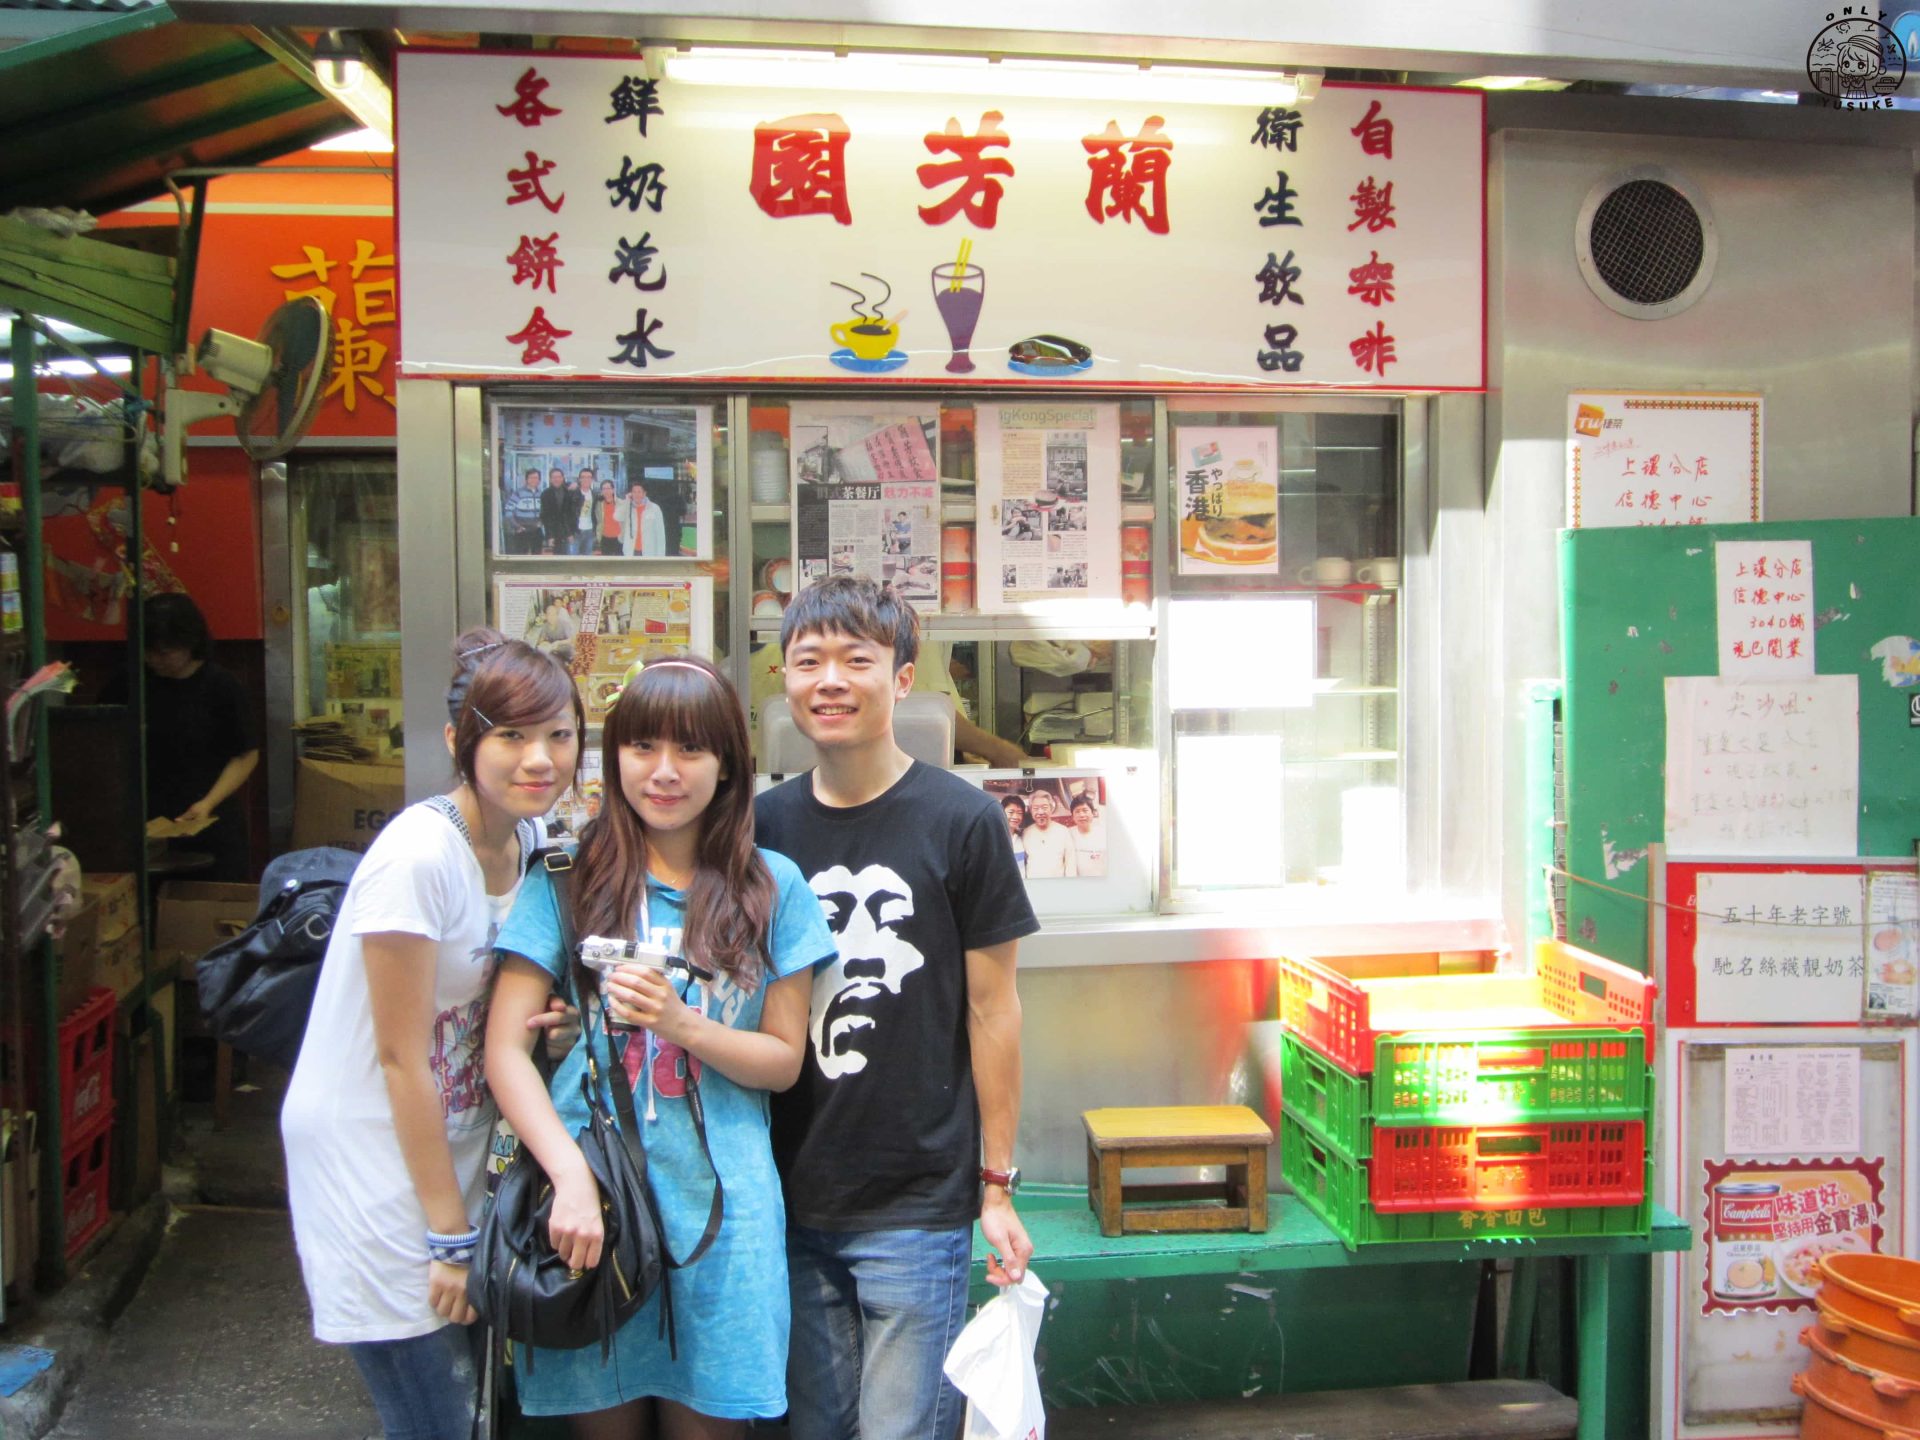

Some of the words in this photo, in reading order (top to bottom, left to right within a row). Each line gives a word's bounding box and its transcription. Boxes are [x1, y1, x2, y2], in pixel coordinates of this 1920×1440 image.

[496, 67, 573, 365] 各式餅食
[1251, 105, 1305, 373] 衛生飲品
[1185, 468, 1210, 522] 香港
[1615, 489, 1713, 511] 信德中心
[1733, 587, 1806, 605] 信德中心
[1722, 903, 1852, 927] 五十年老字號
[1711, 956, 1864, 978] 馳名絲襪靚奶茶
